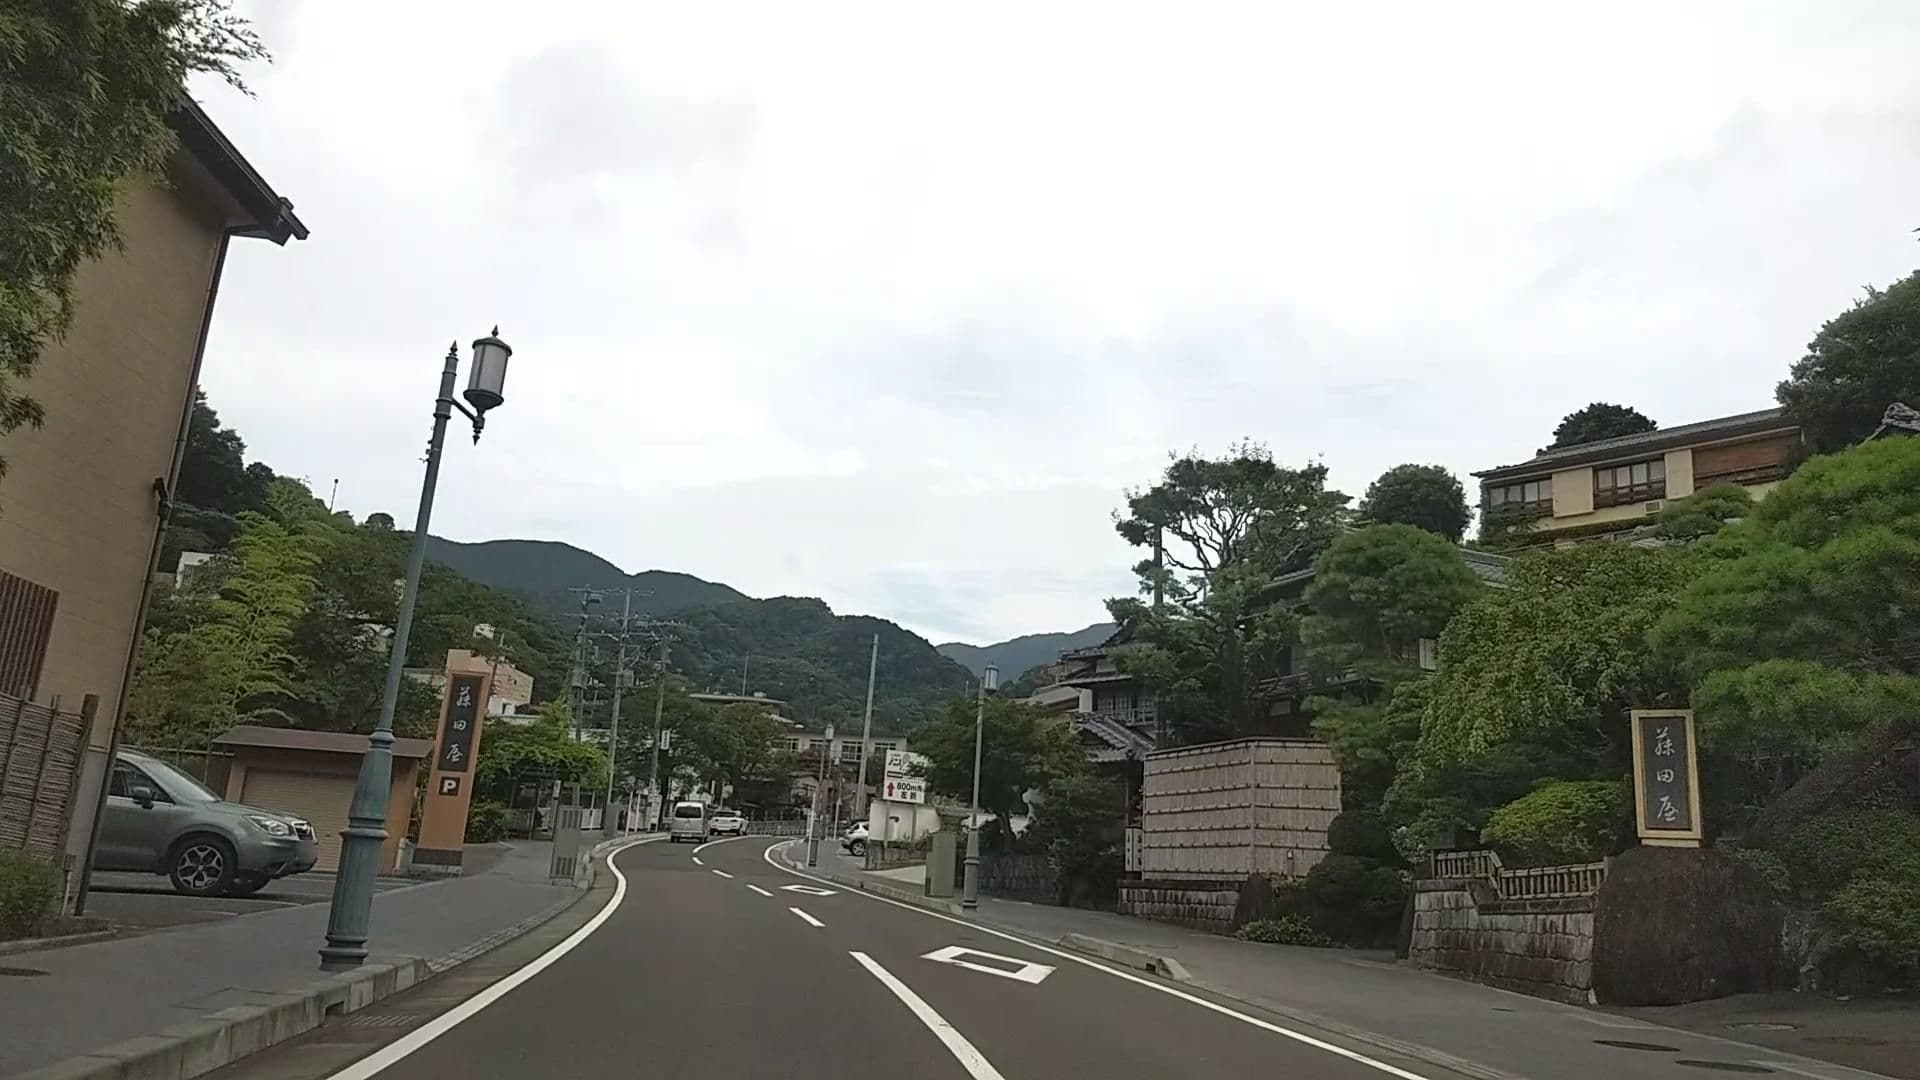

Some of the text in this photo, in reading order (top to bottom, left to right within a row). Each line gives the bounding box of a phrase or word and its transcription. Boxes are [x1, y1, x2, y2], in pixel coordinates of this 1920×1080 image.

[442, 779, 457, 793] P
[1654, 726, 1679, 822] 藤田屋
